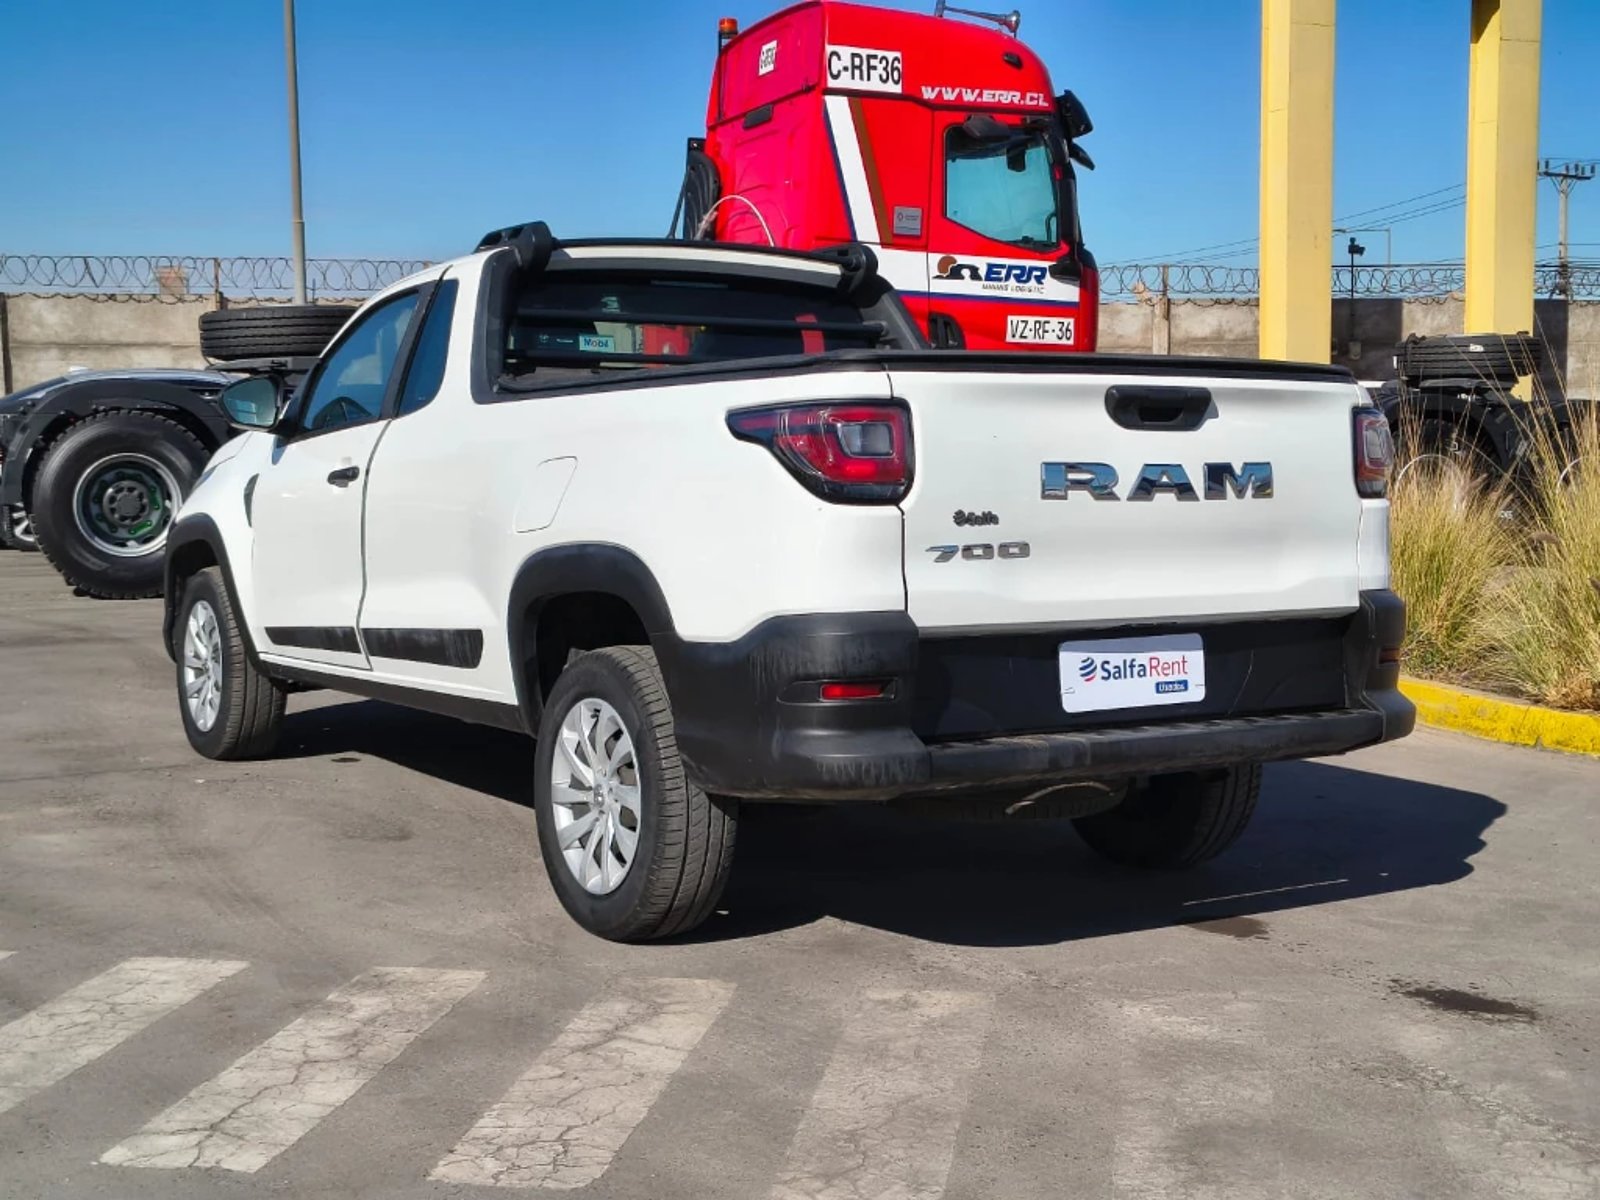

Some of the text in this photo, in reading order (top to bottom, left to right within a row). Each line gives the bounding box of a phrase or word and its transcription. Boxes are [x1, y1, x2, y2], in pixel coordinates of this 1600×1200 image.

[827, 50, 901, 85] C-RF36
[984, 262, 1048, 285] ERR
[1040, 461, 1275, 501] RAM
[925, 541, 1031, 563] 700
